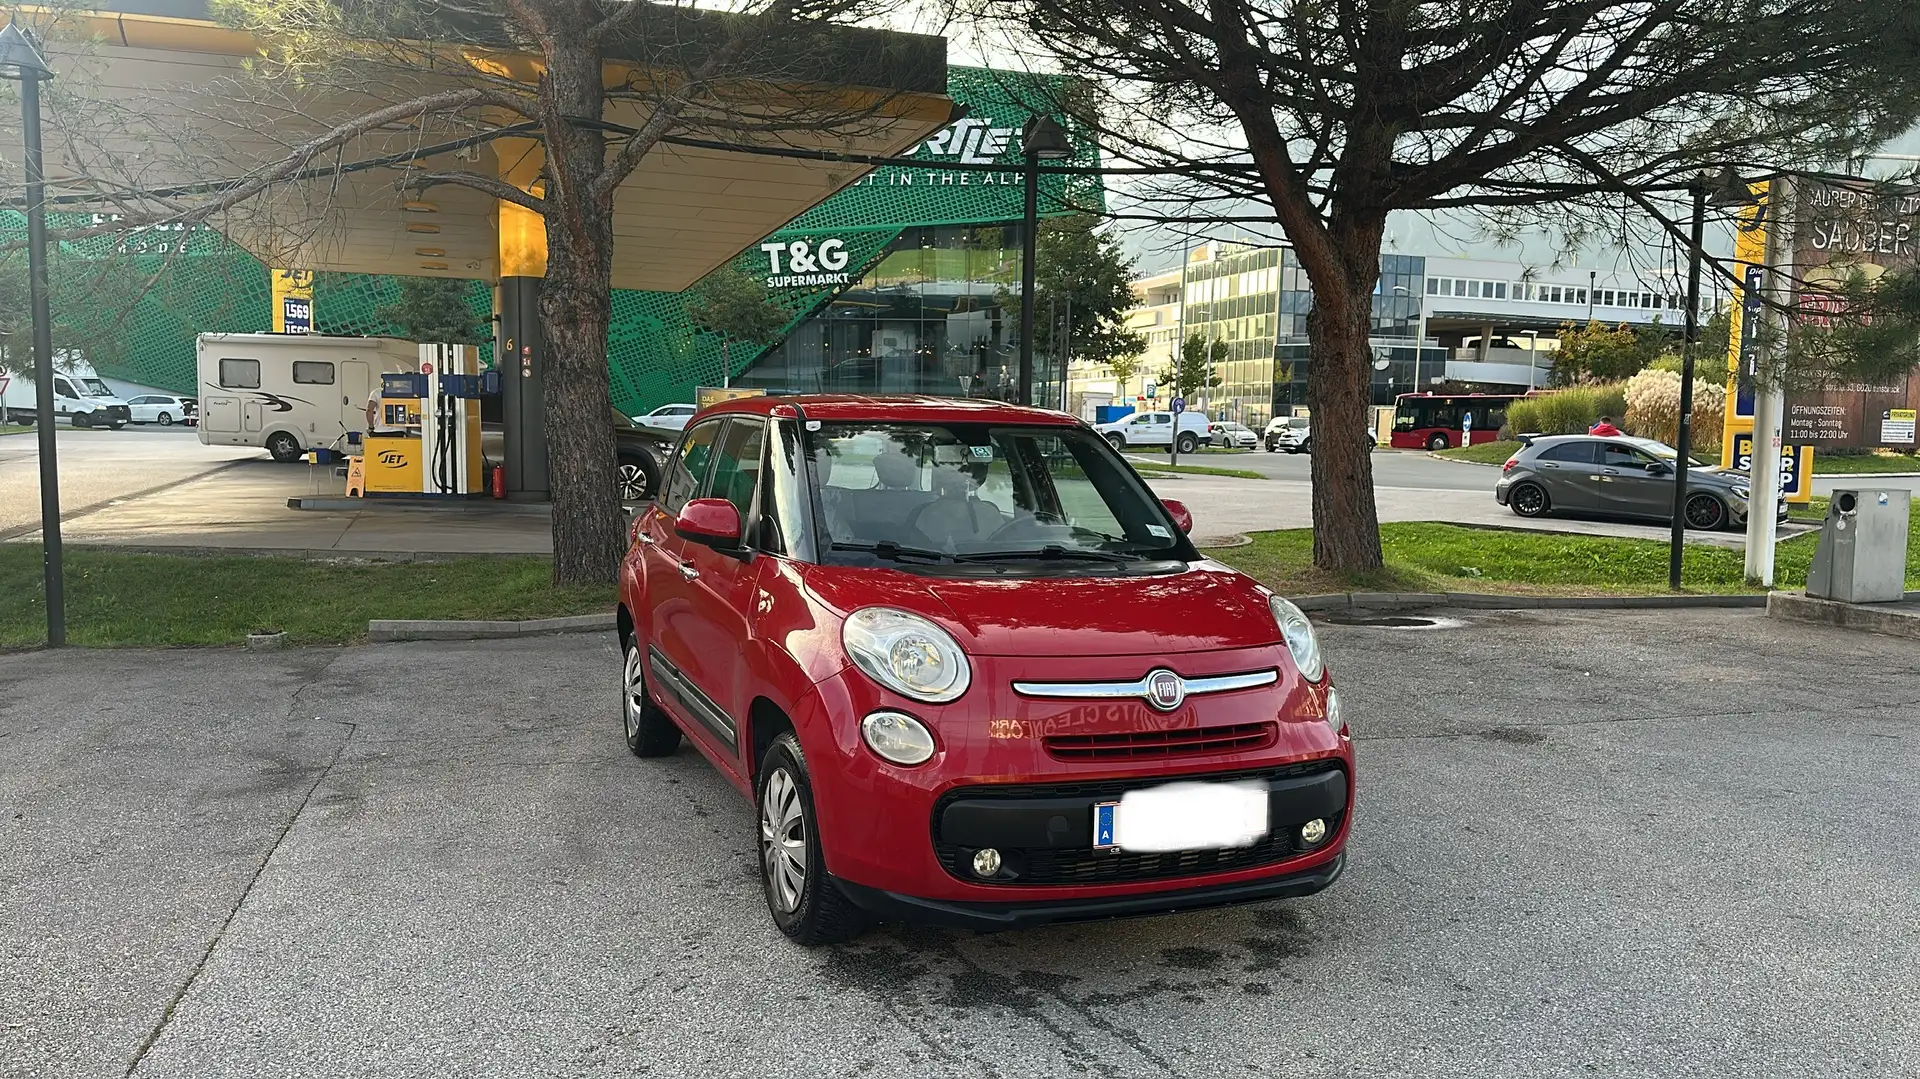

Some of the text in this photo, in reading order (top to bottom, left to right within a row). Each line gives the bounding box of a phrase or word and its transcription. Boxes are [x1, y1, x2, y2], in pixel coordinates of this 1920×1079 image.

[890, 174, 912, 186] IN
[927, 173, 969, 186] THE
[1812, 217, 1911, 256] SAUBER
[761, 238, 849, 274] T&G
[767, 272, 849, 288] SUPERMARKT
[506, 339, 513, 351] 6
[1791, 404, 1846, 416] ÖFFNUNGSZEITEN:
[1791, 418, 1813, 428] Montag
[1817, 418, 1842, 429] Sonntag
[1790, 429, 1849, 439] 11:00 bis 22:00 Uhr
[380, 454, 404, 464] JET
[1157, 682, 1176, 697] FIAT
[1102, 830, 1110, 840] A
